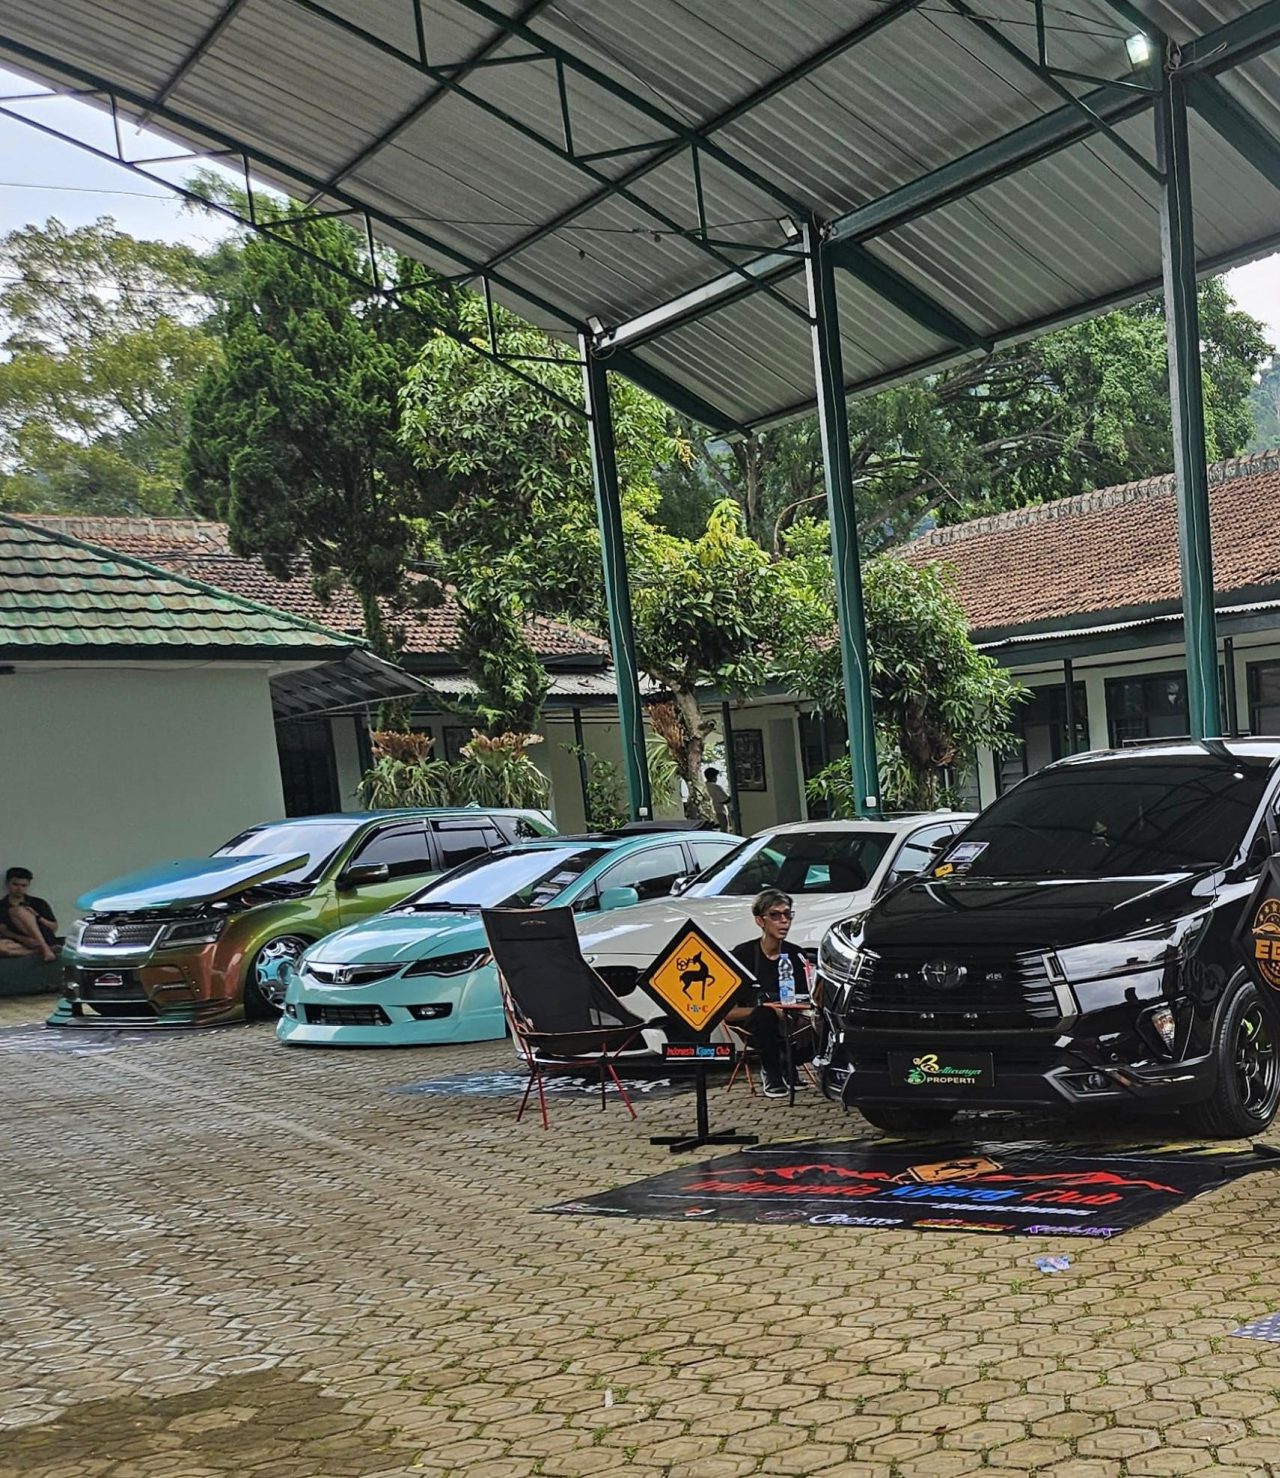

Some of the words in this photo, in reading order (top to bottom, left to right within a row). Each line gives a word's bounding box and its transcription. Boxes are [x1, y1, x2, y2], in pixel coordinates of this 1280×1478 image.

[667, 1047, 695, 1056] Indonesia
[696, 1045, 715, 1057] Kijang
[716, 1046, 730, 1056] Club
[926, 1076, 976, 1084] PROPERTI
[1020, 1189, 1124, 1205] Club
